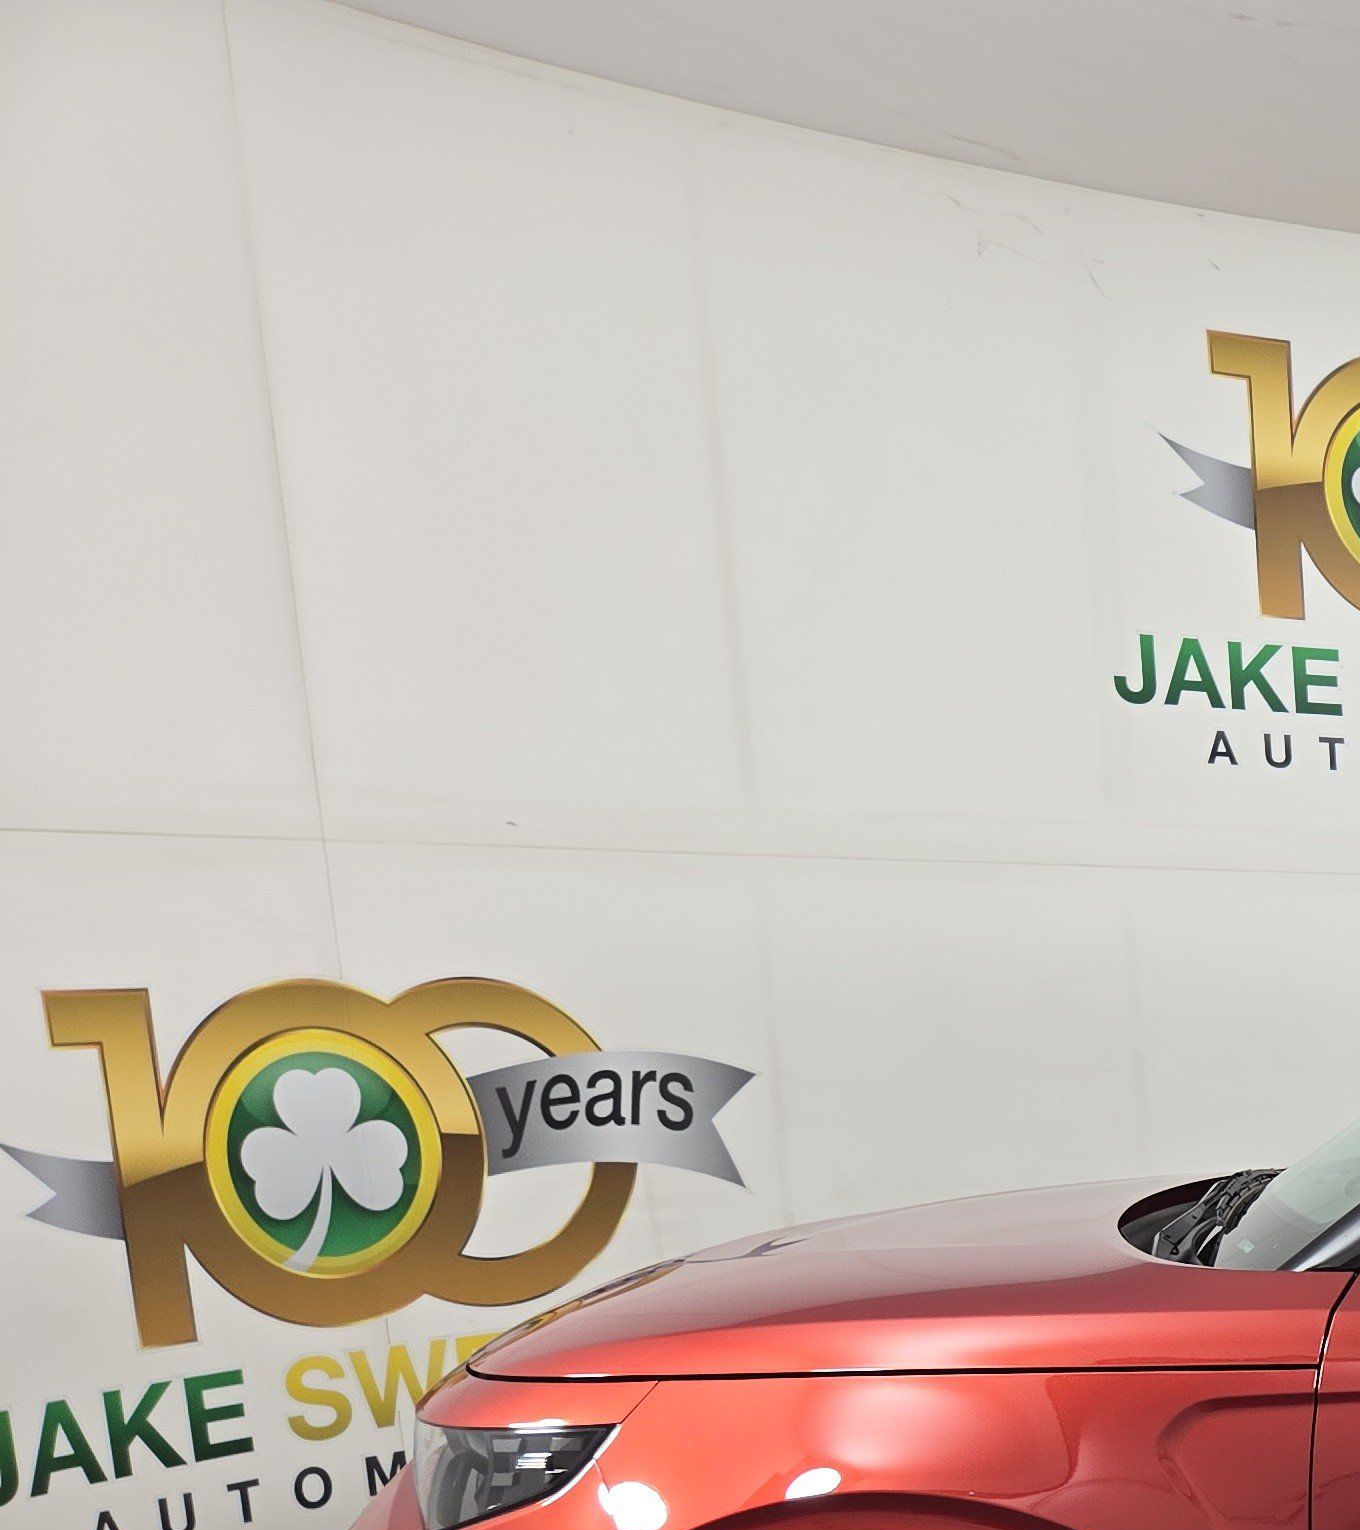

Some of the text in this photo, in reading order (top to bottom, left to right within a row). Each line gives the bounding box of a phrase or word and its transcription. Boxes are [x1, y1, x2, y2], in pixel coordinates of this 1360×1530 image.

[1113, 632, 1344, 717] JAKE
[495, 1068, 696, 1159] years
[40, 976, 638, 1348] 100
